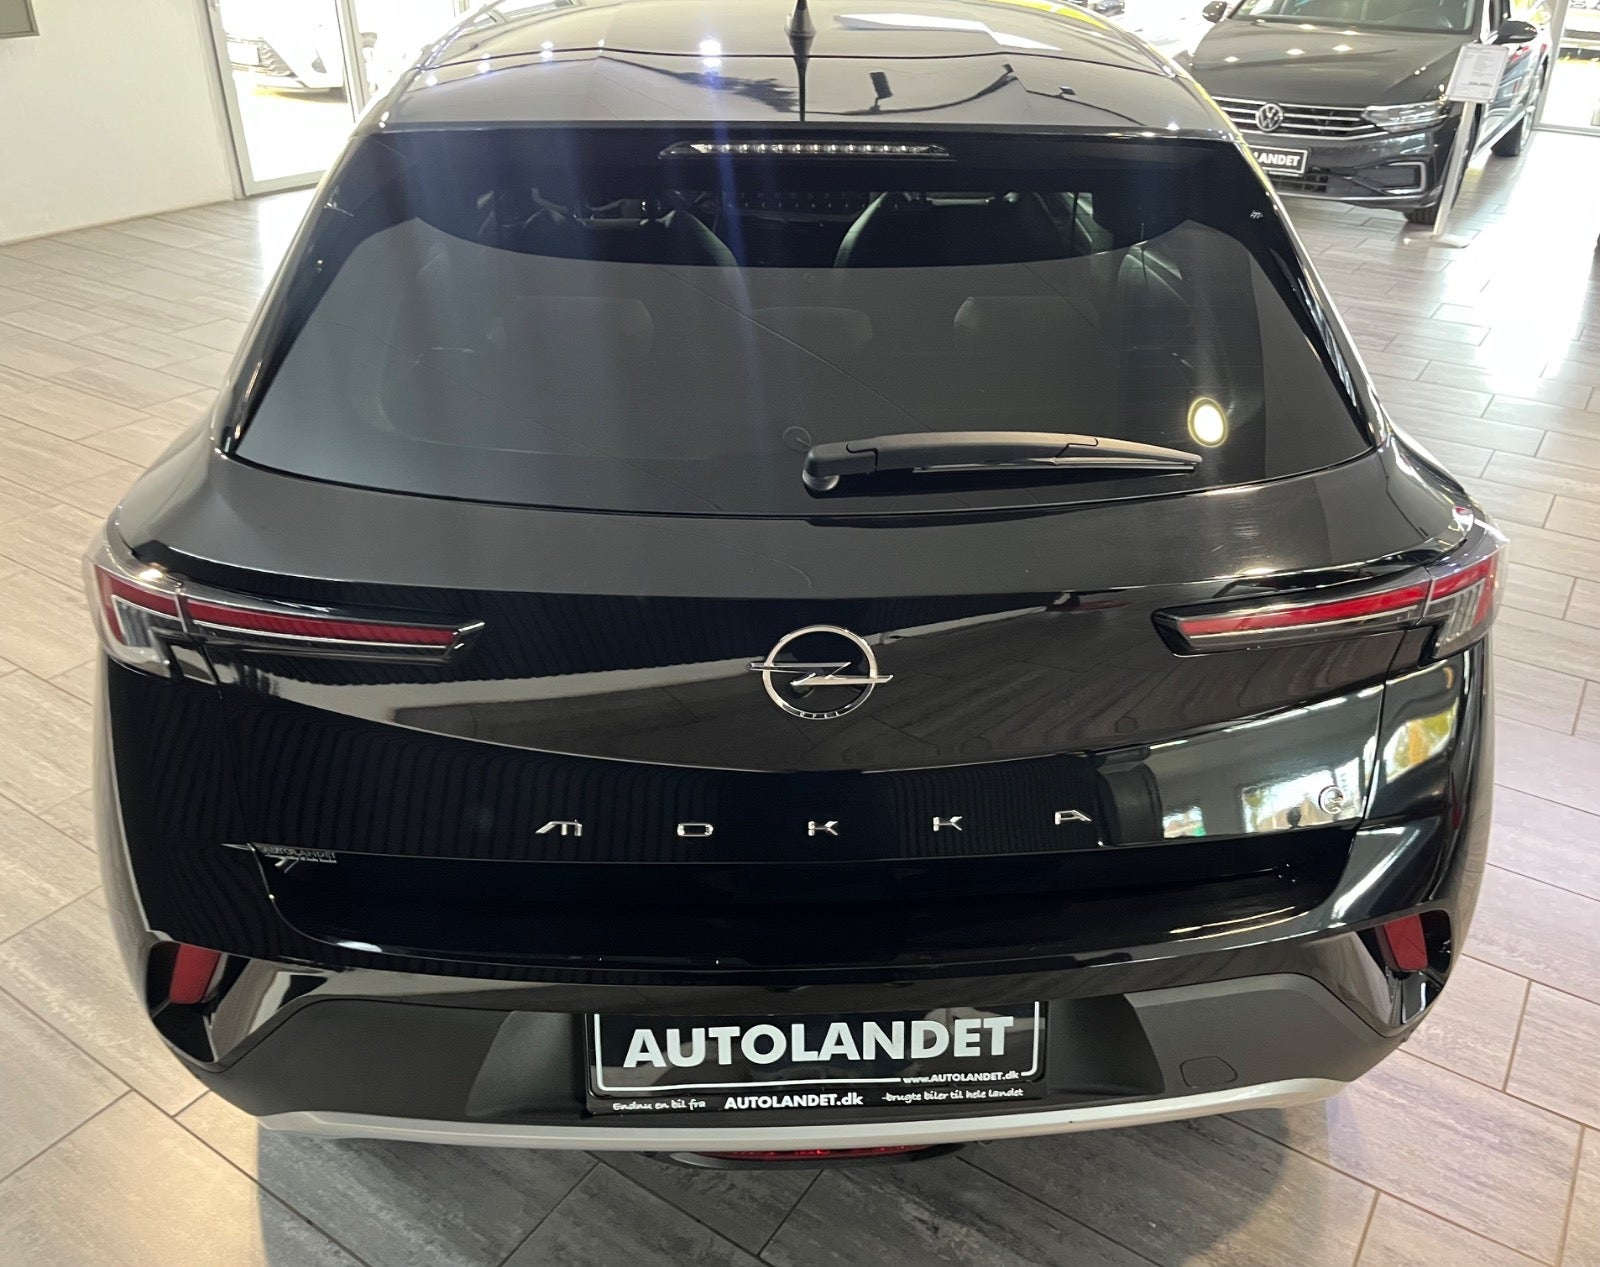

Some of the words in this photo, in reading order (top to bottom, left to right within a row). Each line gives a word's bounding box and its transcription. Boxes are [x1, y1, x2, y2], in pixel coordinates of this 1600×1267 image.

[535, 809, 1093, 838] MOKKA
[623, 1016, 1015, 1068] AUTOLANDET
[902, 1070, 1020, 1084] www.AUTOLANDET.dk
[612, 1101, 653, 1111] Endnu
[671, 1099, 688, 1109] bil
[688, 1098, 706, 1111] fra
[724, 1093, 863, 1110] AUTOLANDET.dk
[923, 1090, 949, 1101] biler
[950, 1089, 963, 1100] til
[965, 1089, 987, 1099] hele
[988, 1087, 1024, 1098] landet
